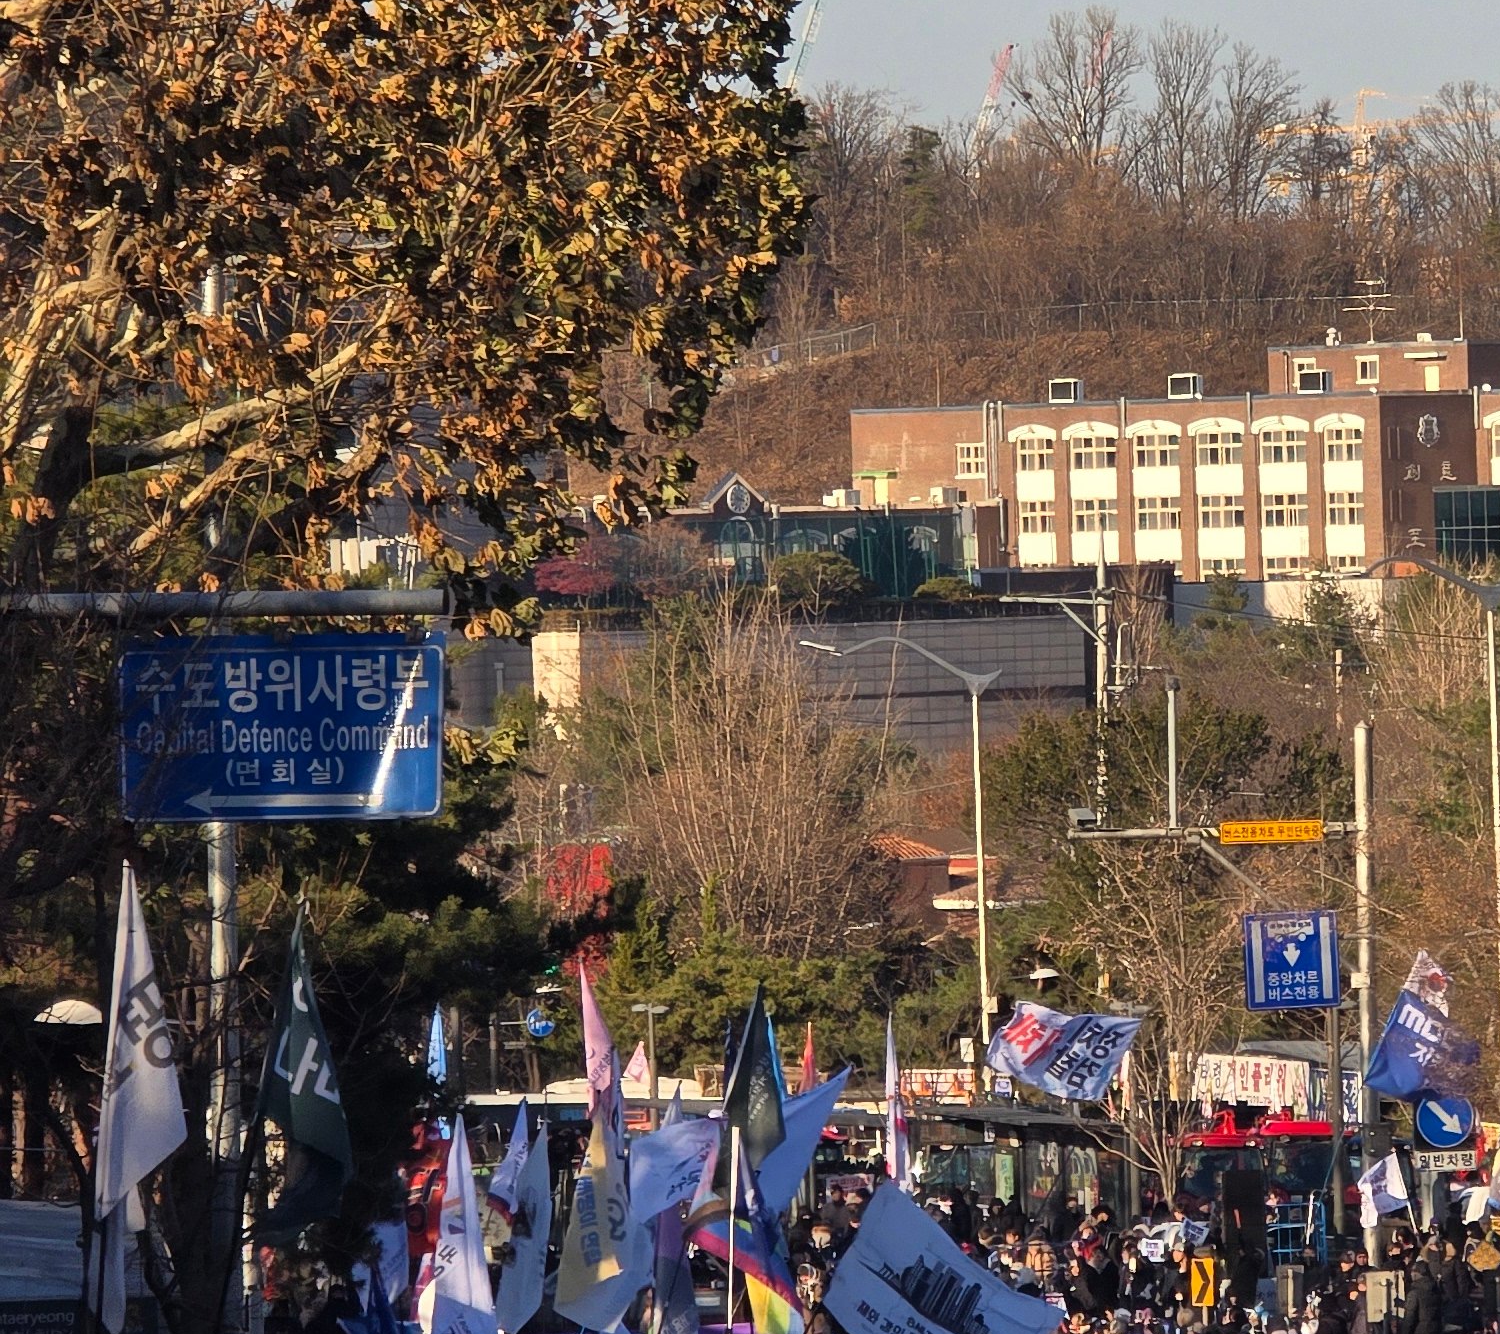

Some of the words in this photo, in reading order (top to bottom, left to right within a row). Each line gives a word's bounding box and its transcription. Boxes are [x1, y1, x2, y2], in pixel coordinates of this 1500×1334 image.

[135, 654, 429, 715] 수도방위사령부
[221, 720, 313, 754] Defence
[271, 758, 295, 785] 회
[1268, 985, 1320, 1002] 버스전용
[1419, 1152, 1474, 1169] 일반차량
[0, 1311, 75, 1327] taeryeong
